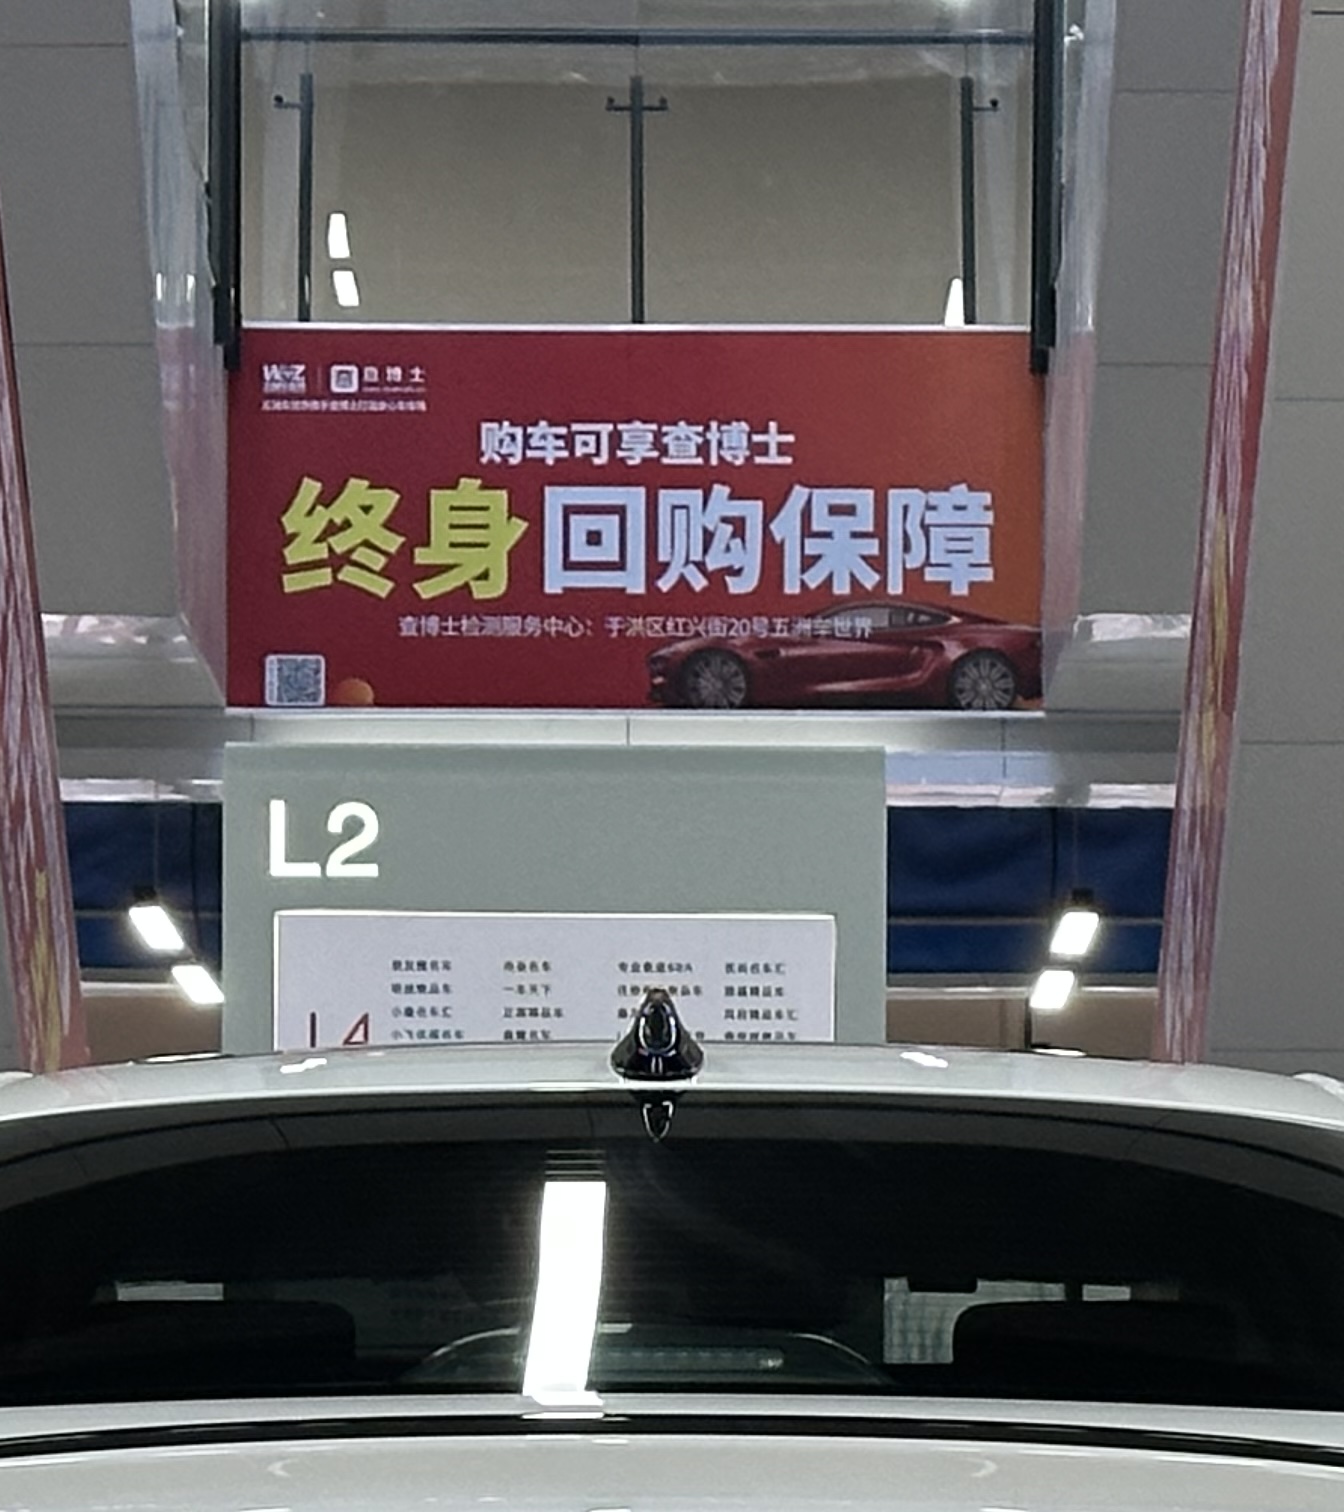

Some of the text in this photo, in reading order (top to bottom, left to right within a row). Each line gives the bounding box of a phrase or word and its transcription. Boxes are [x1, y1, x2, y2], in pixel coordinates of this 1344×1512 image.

[479, 421, 795, 467] 购车可享查博士
[280, 476, 995, 600] 终身回购保障
[268, 798, 380, 878] L2
